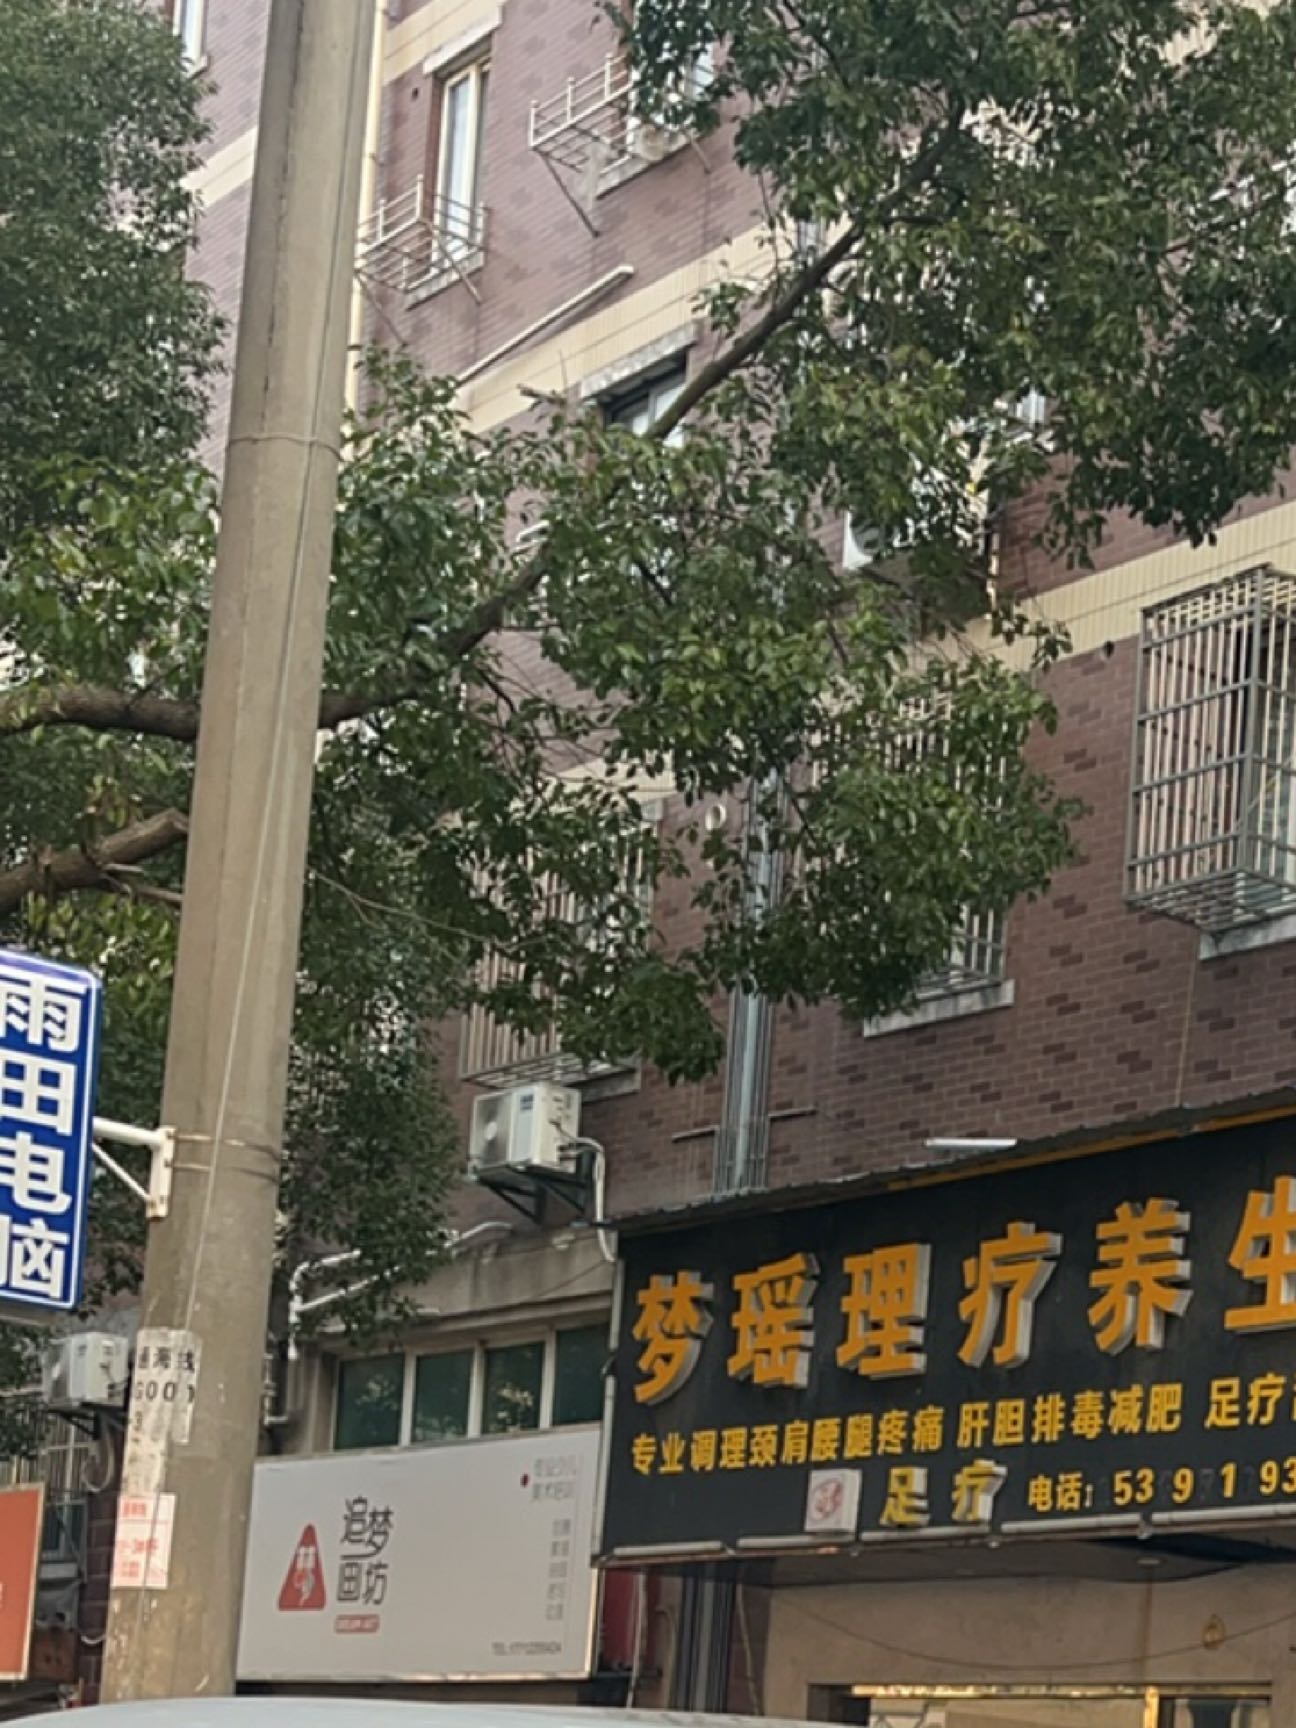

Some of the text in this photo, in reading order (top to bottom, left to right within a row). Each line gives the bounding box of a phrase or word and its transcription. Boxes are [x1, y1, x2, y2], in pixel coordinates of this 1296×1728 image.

[631, 1406, 945, 1475] 专业调理颈肩腰腿疼痛
[958, 1384, 1183, 1447] 肝胆排毒减肥
[879, 1460, 1007, 1525] 足疗
